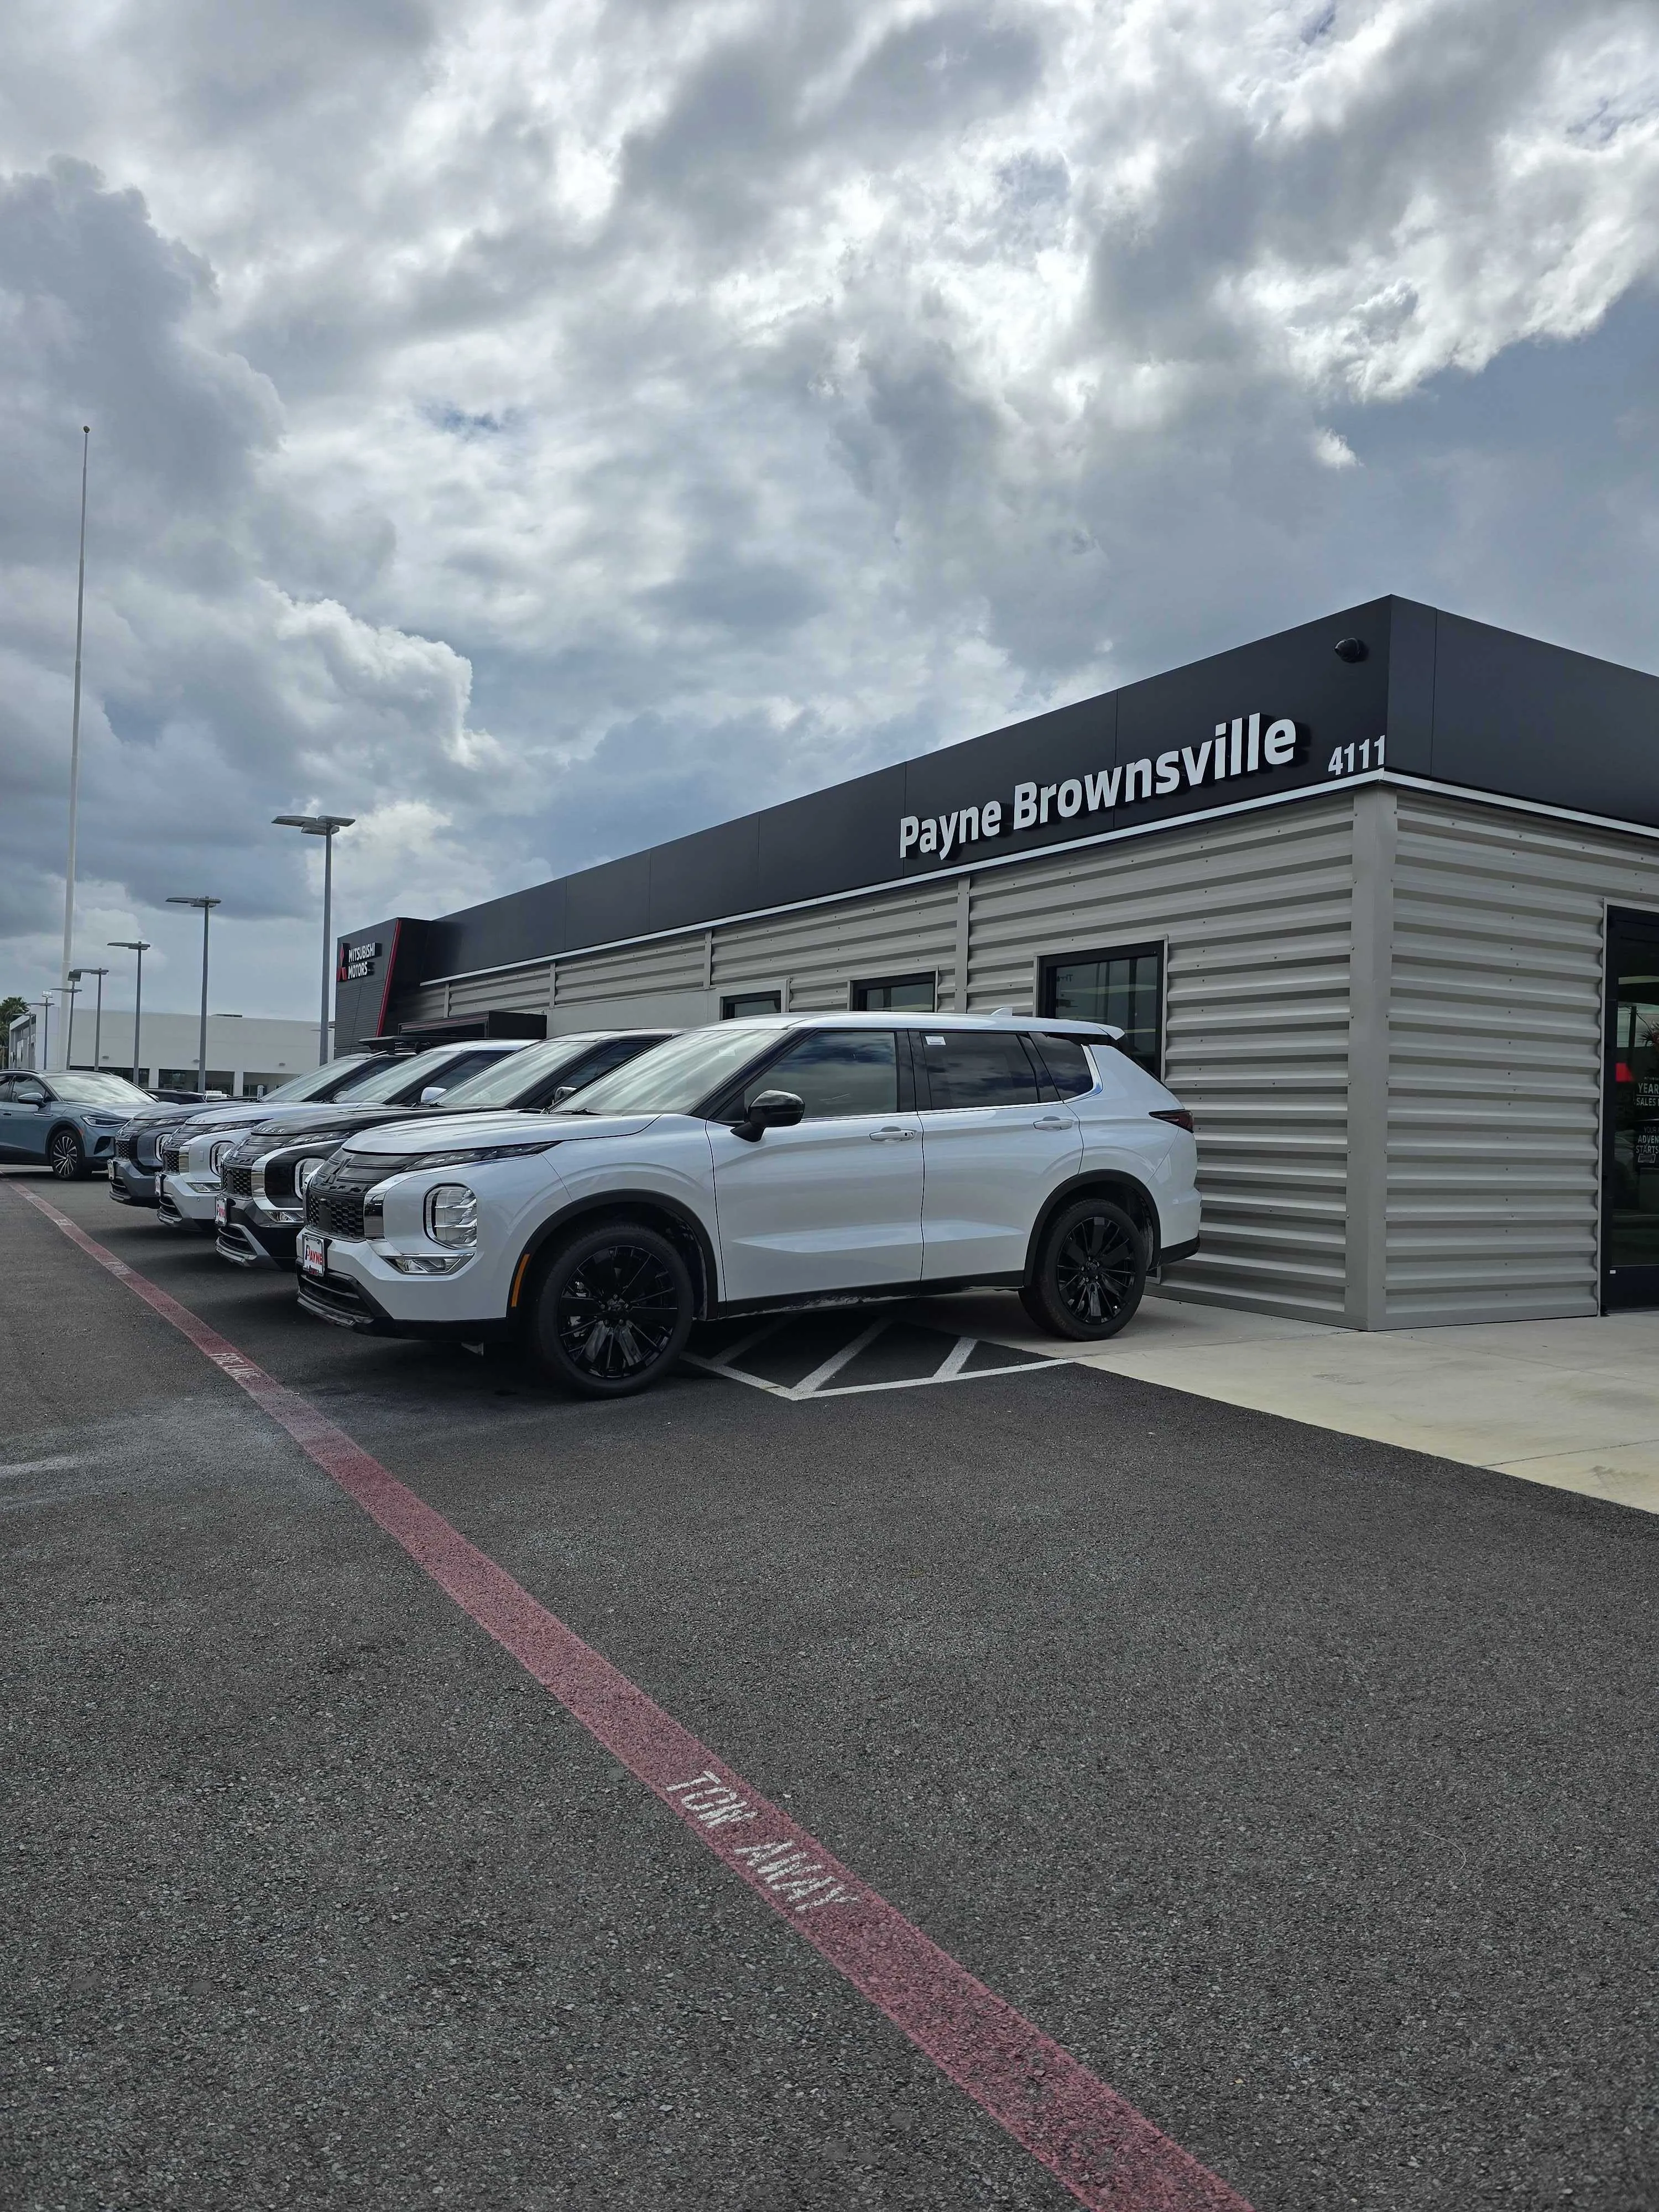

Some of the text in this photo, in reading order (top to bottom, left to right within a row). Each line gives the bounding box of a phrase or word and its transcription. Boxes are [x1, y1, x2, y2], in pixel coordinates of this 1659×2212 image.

[1328, 734, 1386, 776] 4111
[900, 712, 1297, 860] Payne Brownsville
[348, 942, 375, 963] MITSUBISHI
[348, 961, 368, 979] MOTORS
[1636, 1097, 1656, 1106] SALES
[1636, 1145, 1659, 1154] STARTS
[305, 1244, 322, 1265] PAYNE
[666, 1770, 858, 1912] TOW AWAY
